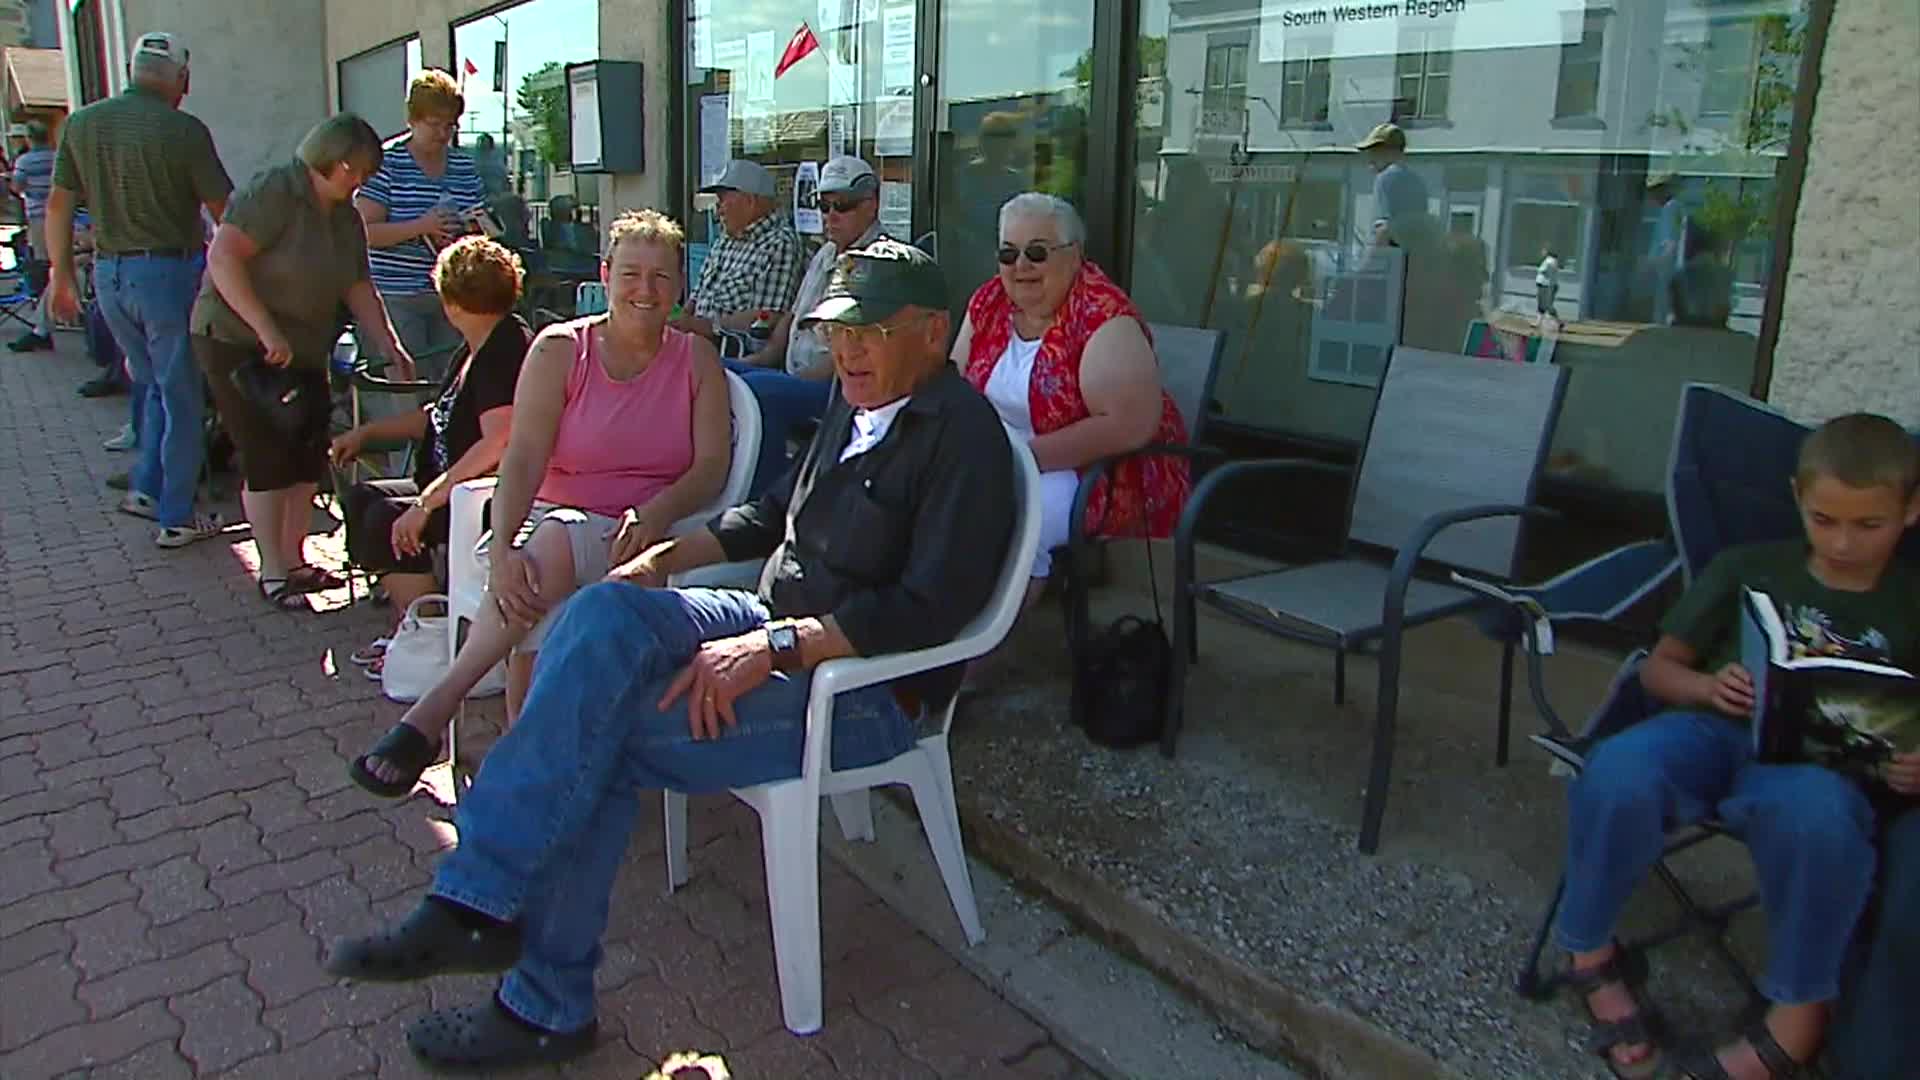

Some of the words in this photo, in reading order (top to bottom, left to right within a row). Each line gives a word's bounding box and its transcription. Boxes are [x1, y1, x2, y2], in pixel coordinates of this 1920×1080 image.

[1283, 9, 1327, 26] South
[1333, 4, 1399, 22] Western
[1405, 0, 1466, 18] Region
